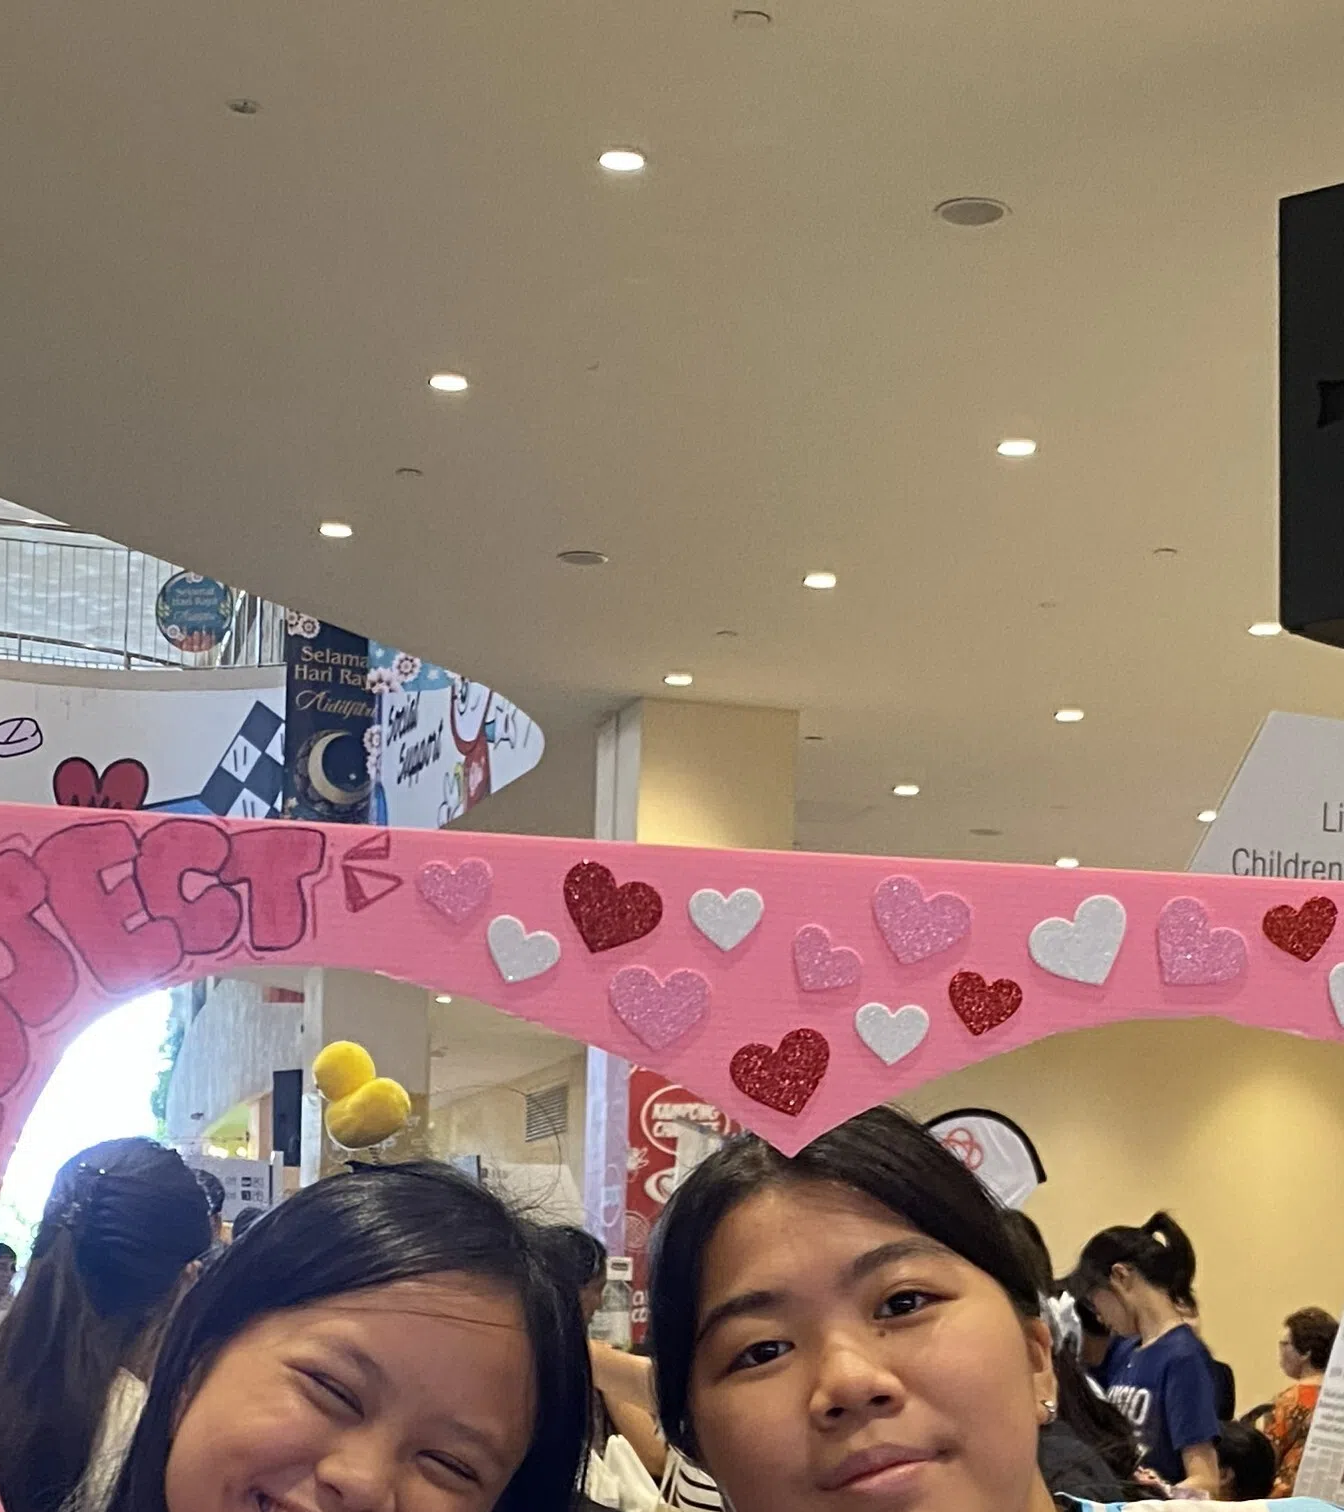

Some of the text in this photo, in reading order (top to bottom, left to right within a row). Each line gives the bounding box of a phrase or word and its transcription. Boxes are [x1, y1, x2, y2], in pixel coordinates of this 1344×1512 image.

[300, 646, 369, 668] Selama
[294, 664, 369, 692] Hari Ray
